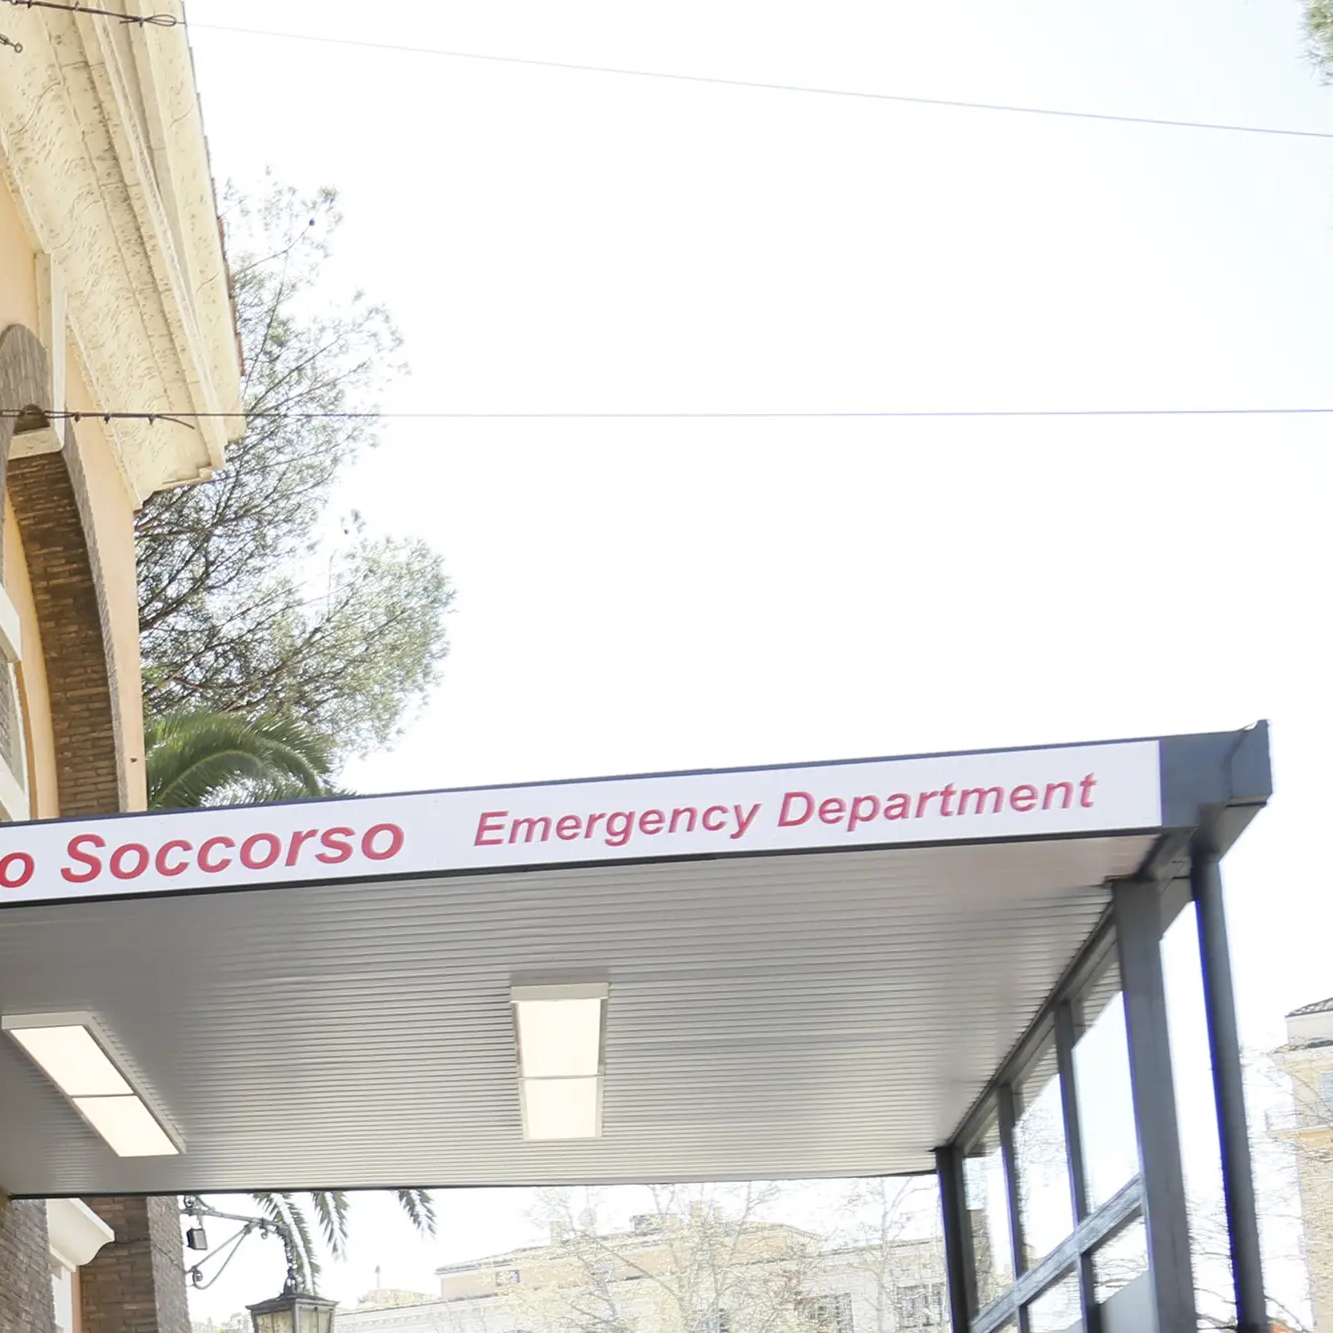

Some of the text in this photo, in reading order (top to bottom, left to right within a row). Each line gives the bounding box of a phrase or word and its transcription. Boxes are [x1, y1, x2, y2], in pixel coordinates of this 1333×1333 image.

[473, 773, 1098, 848] Emergency Department
[60, 822, 405, 884] Soccorso
